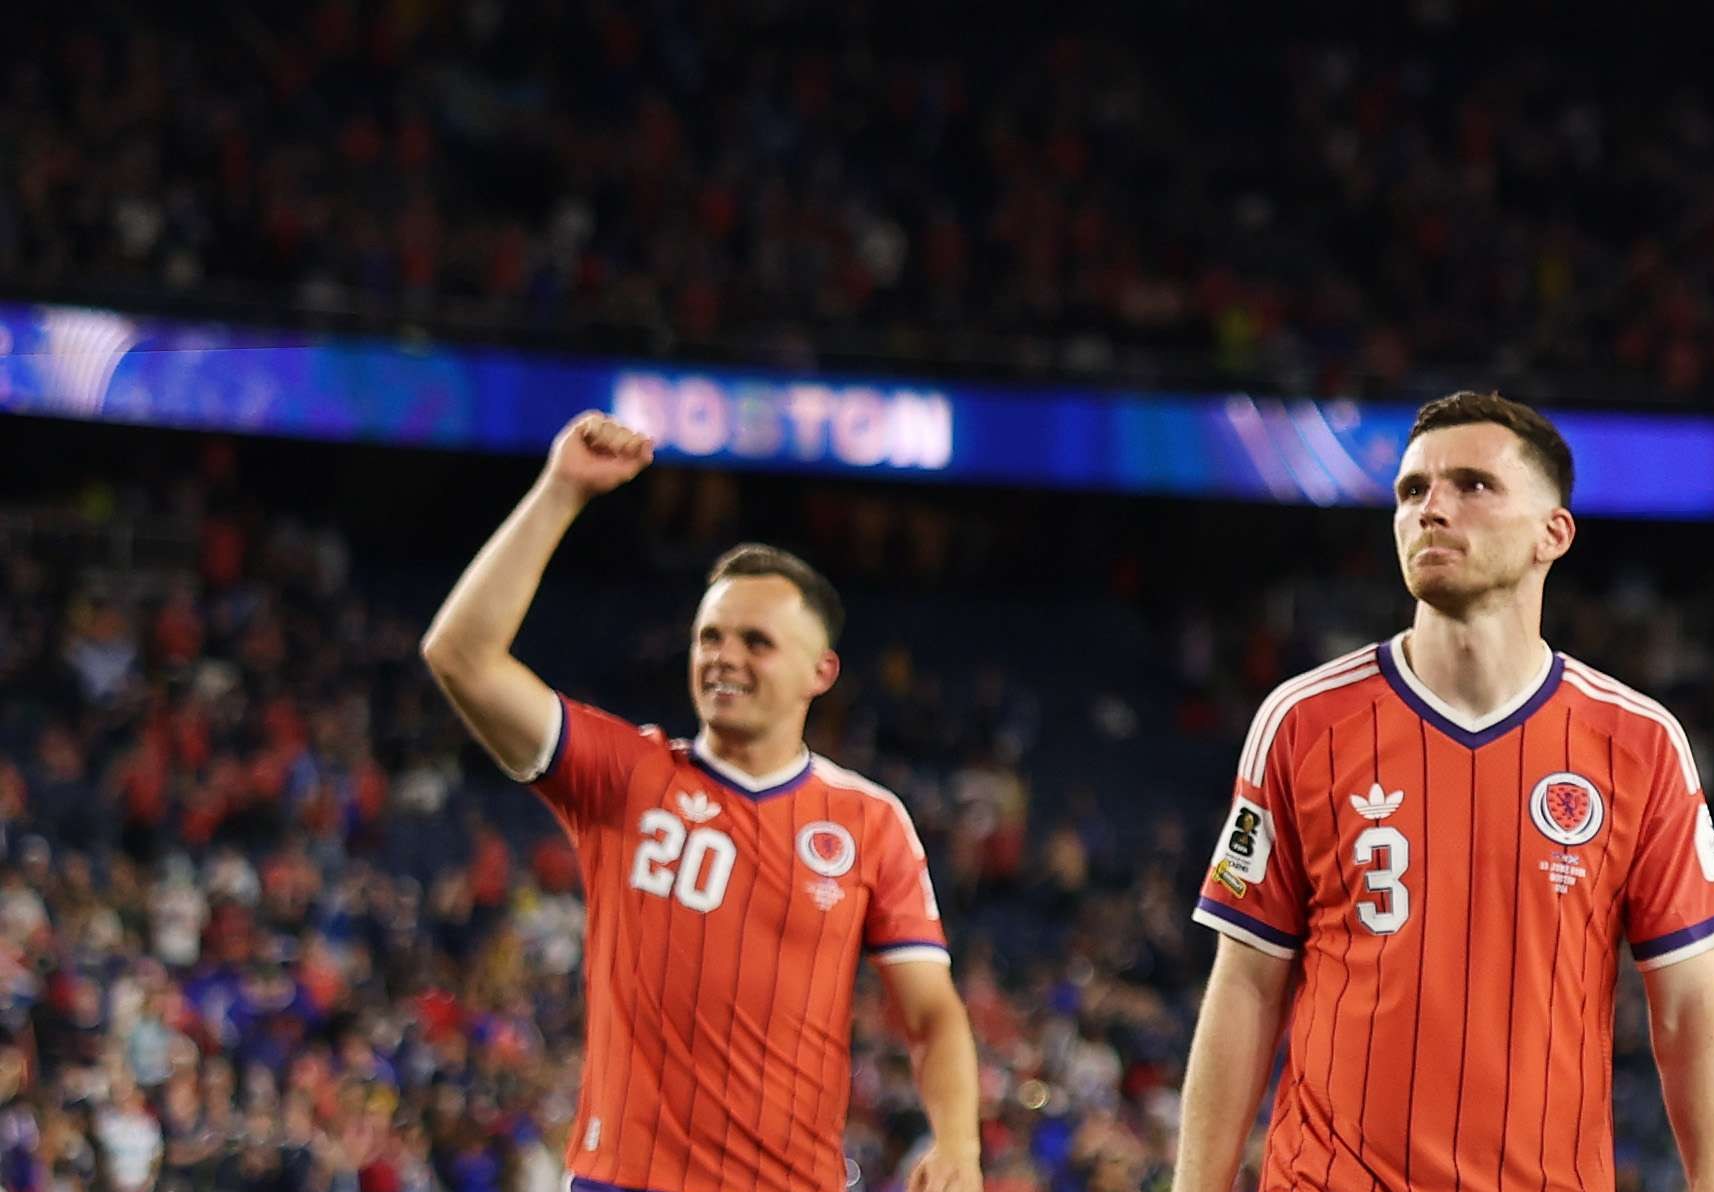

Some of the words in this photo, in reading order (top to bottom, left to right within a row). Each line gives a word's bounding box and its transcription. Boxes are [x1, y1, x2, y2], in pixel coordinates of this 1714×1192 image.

[613, 368, 953, 471] BOSTON
[630, 807, 737, 914] 20
[1353, 826, 1409, 935] 3
